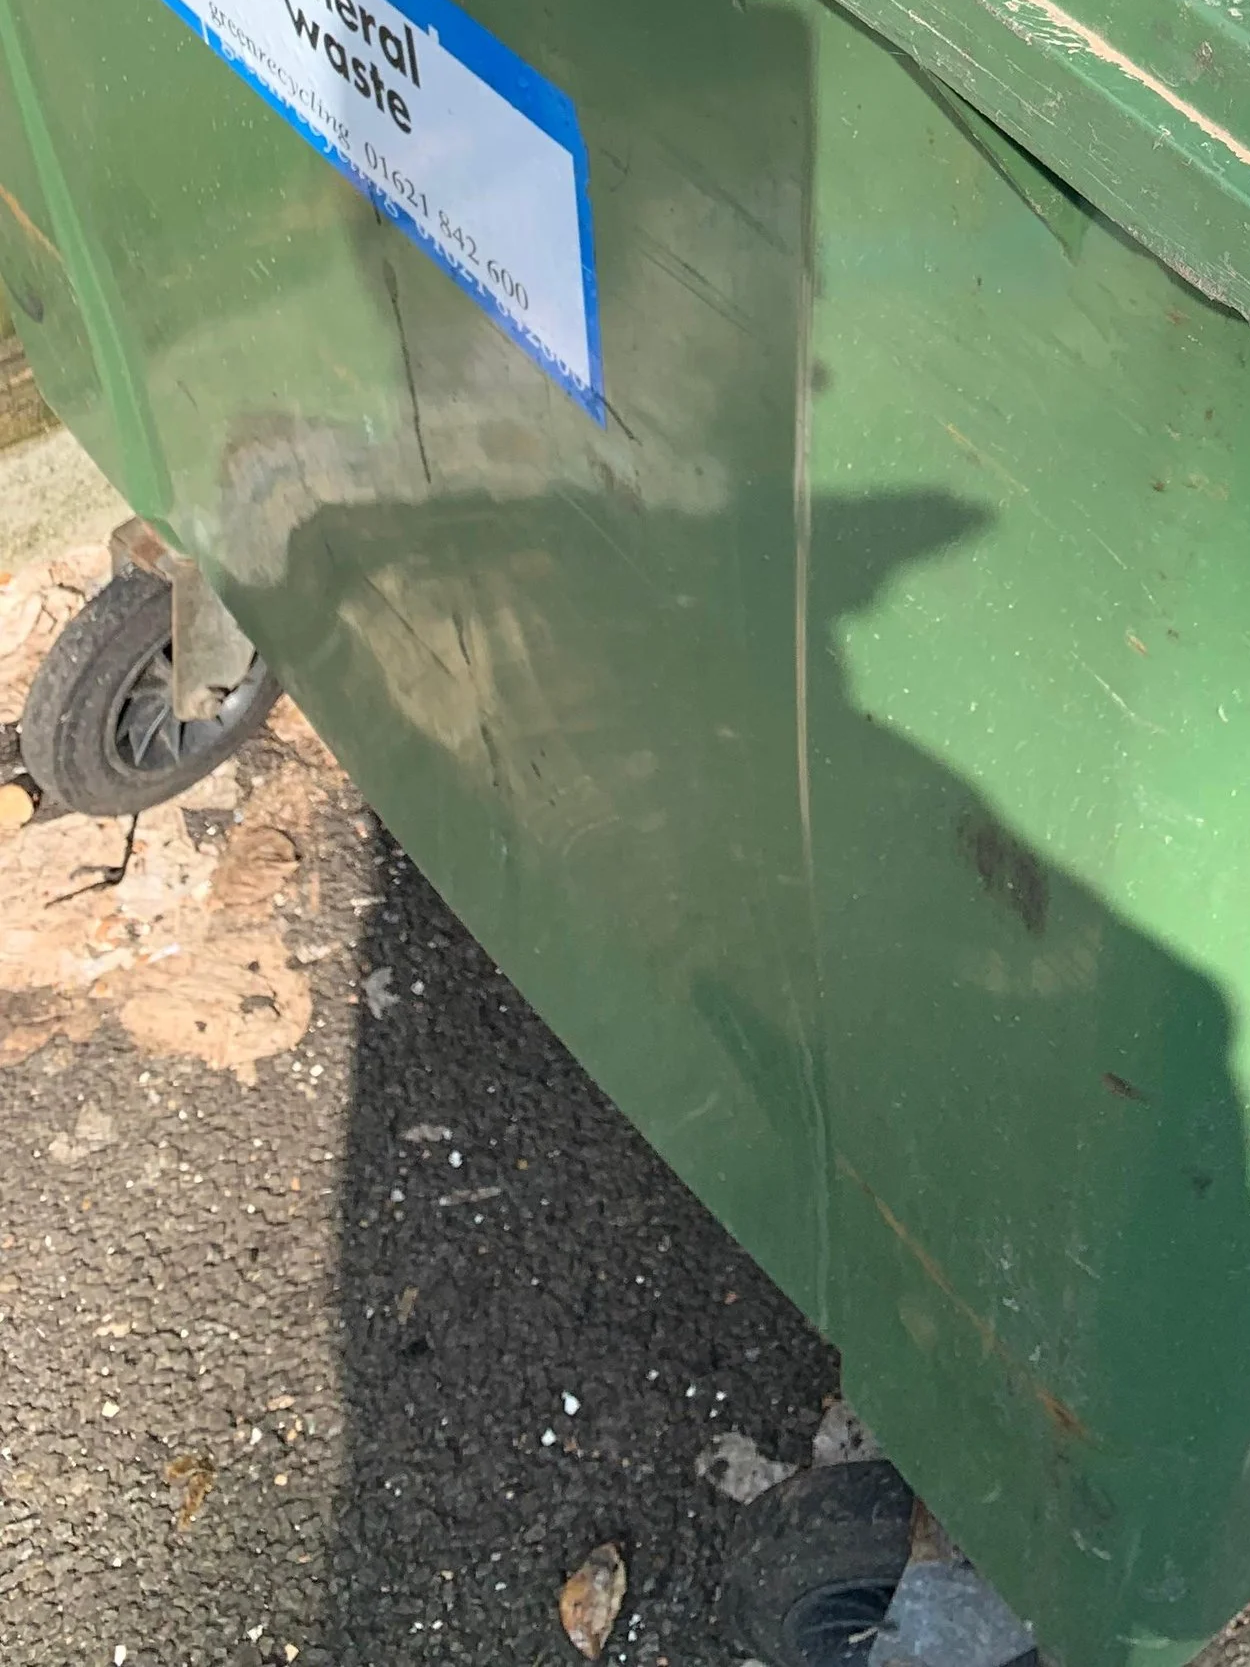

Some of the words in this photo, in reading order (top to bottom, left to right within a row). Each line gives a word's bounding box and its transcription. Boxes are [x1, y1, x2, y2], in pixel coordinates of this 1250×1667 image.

[209, 1, 351, 151] greenrecycling
[364, 142, 429, 218] 01621
[439, 210, 479, 266] 842
[487, 260, 529, 311] 600
